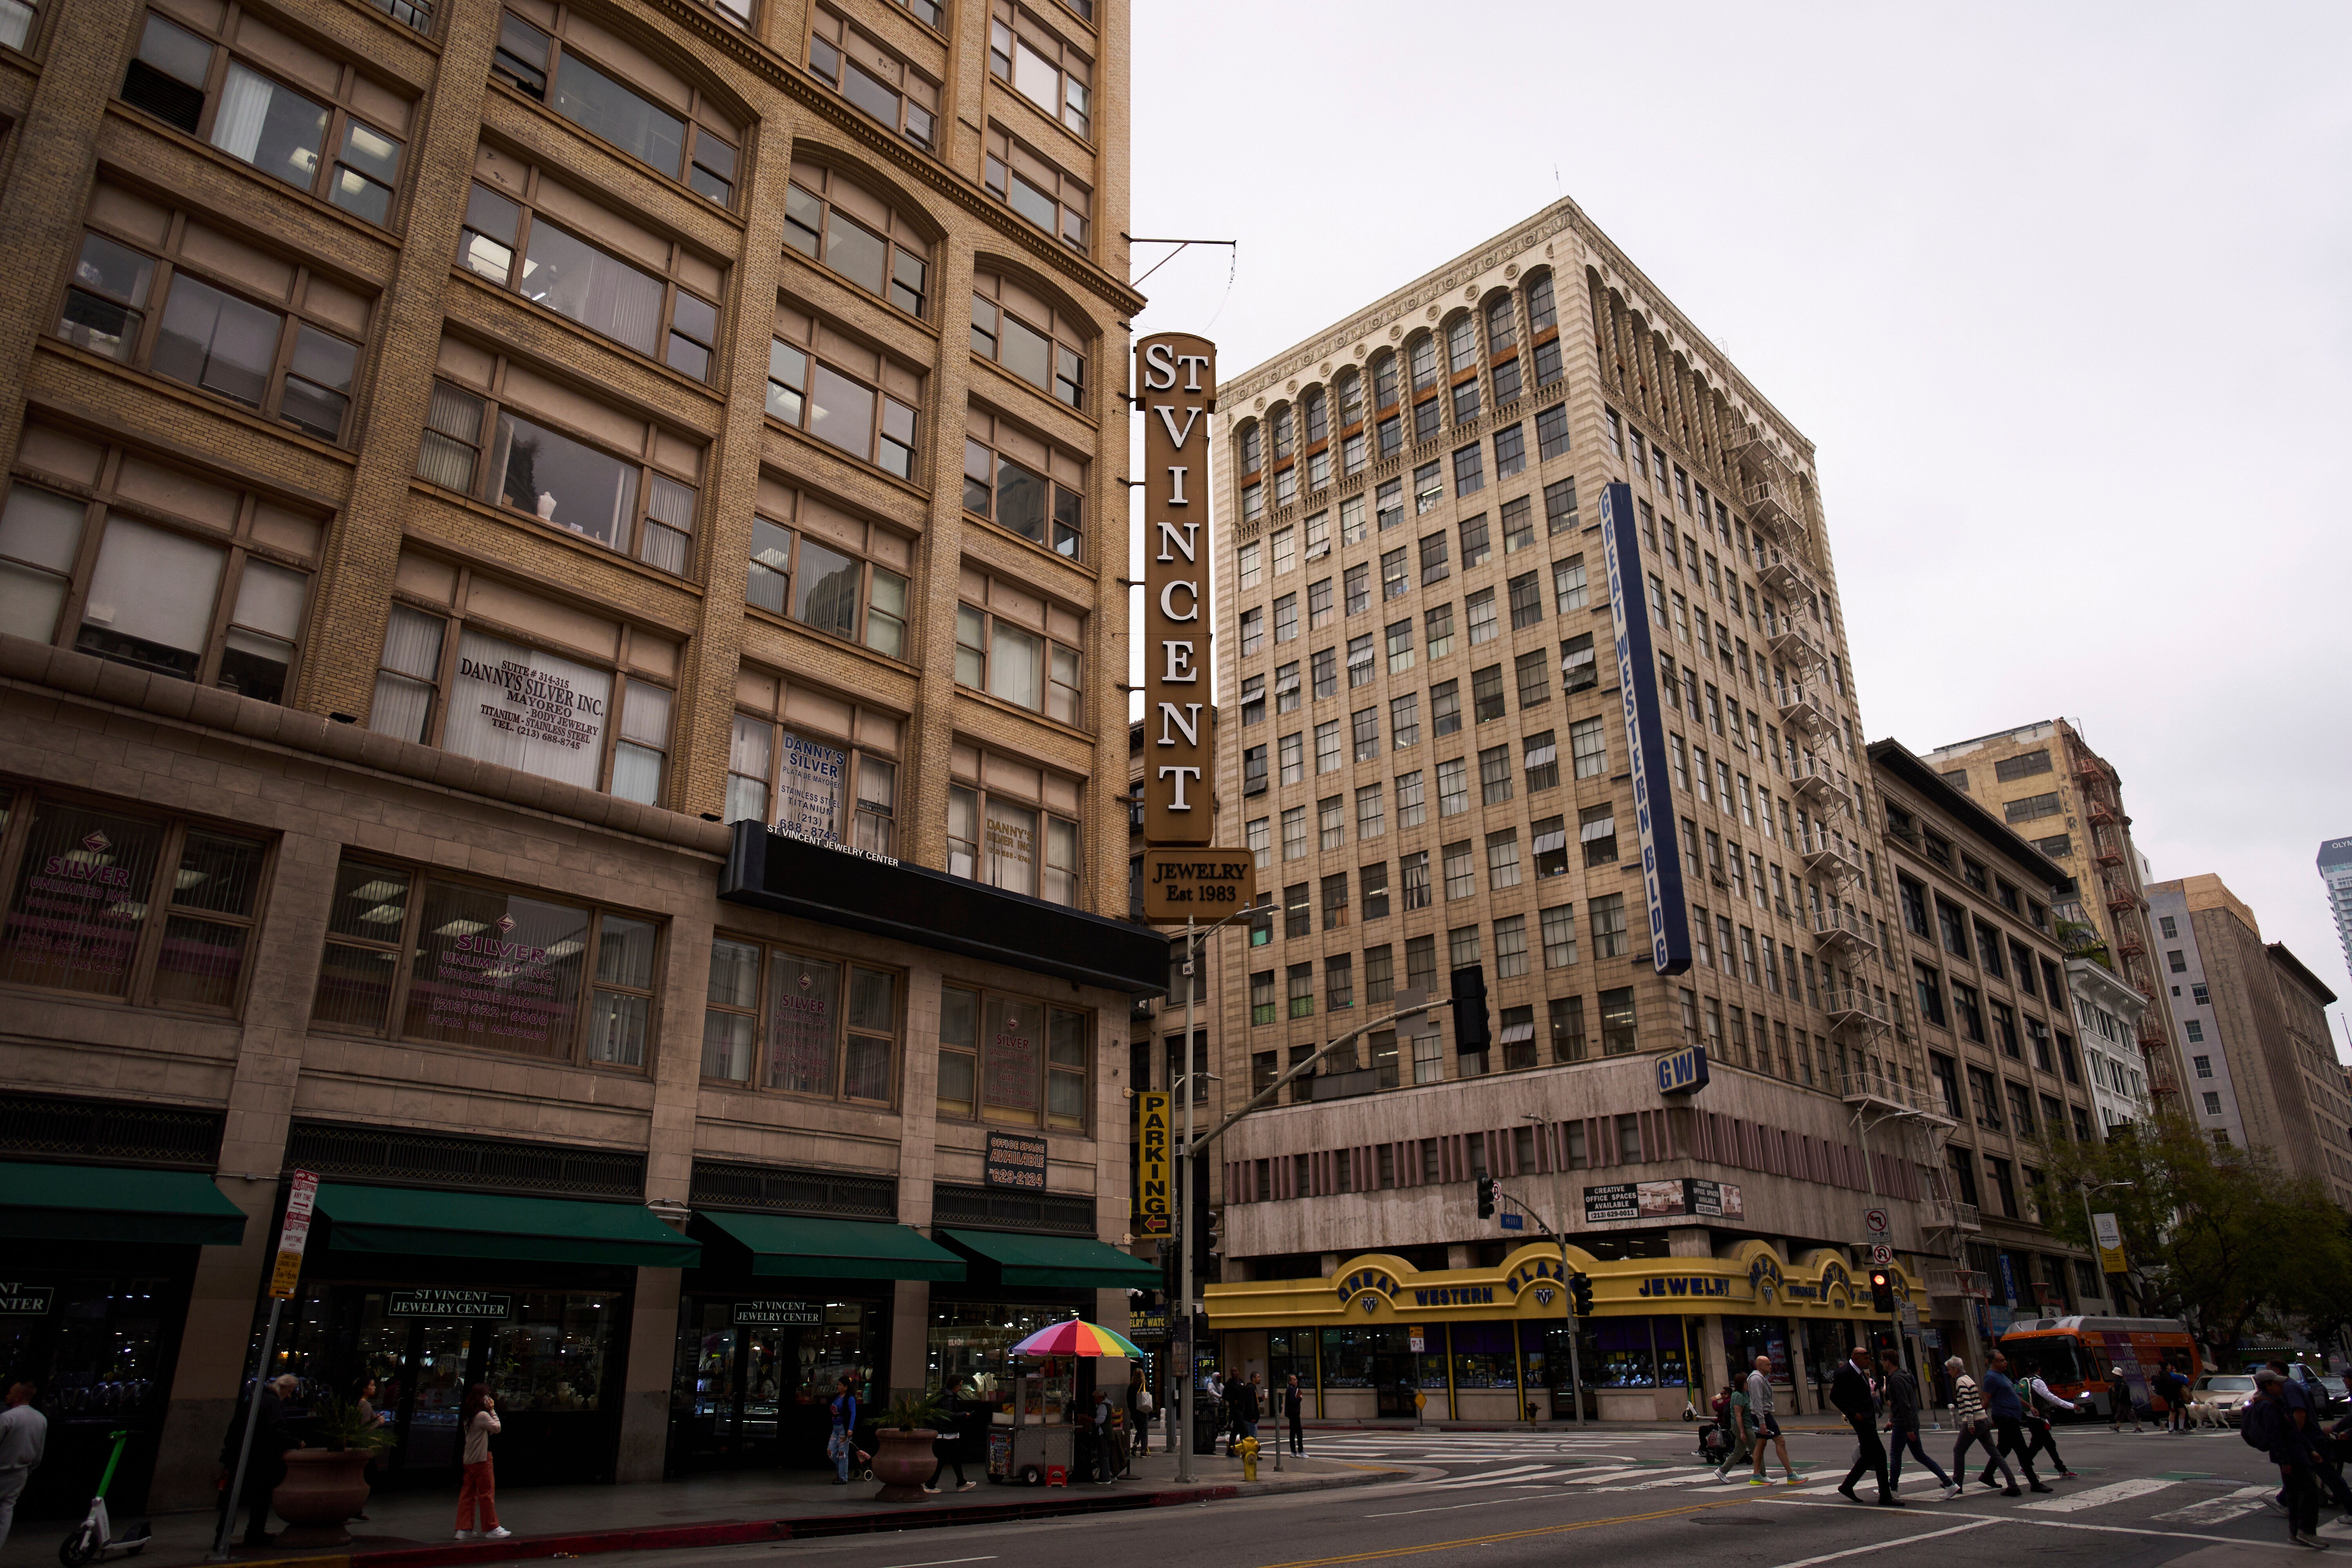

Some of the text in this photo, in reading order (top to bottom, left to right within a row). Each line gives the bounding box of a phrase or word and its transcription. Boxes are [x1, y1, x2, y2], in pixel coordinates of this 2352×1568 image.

[1145, 343, 1209, 811] ST VINCENT
[502, 661, 529, 676] SUITE
[539, 672, 569, 688] 314-315
[460, 658, 603, 717] DANNY'S SILVER INC.
[507, 691, 572, 717] MAYOREO
[481, 704, 590, 744] TITANIUM STAINLESS STEEL
[531, 709, 599, 736] BODY JEWELRY
[1601, 492, 1667, 967] GREAT WESTERN BLDG
[492, 718, 580, 750] TEL. (213) 688-8745
[784, 736, 844, 765] DANNY'S
[789, 753, 838, 778] SILVER
[783, 766, 842, 789] PLATA DE MAYOREO
[782, 785, 840, 809] STAINLESS STEEL
[788, 797, 833, 816] TITANIUM
[798, 812, 822, 826] (213)
[987, 818, 1034, 842] DANNY'S
[987, 831, 1013, 848] SILVER
[767, 825, 898, 867] ST. VINCENT JEWELRY CENTER
[1018, 855, 1031, 864] 8745
[45, 857, 129, 887] SILVER
[1152, 863, 1248, 883] JEWELRY
[30, 876, 134, 904] UNLIMITED INC.
[1166, 885, 1236, 901] Est 1983
[26, 896, 132, 922] WHOLESALE SILVER
[42, 918, 107, 936] SUITE 216
[456, 934, 547, 965] SILVER
[14, 952, 123, 975] PLATA DE MAYOREO
[443, 951, 555, 981] UNLIMITED INC.
[439, 966, 554, 996] WHOLESALE SILVER
[461, 988, 532, 1008] SUITE 216
[781, 994, 826, 1014] SILVER
[434, 997, 548, 1025] (213) 622 6800
[775, 1009, 813, 1024] UNLIMITED
[428, 1015, 546, 1041] PLATA DE MAYOREO
[774, 1025, 829, 1040] WHOLESALE SILVER
[784, 1040, 818, 1052] SUITE 216
[996, 1034, 1029, 1051] SILVER
[989, 1047, 1020, 1060] UNLIMITED
[800, 1069, 827, 1079] MAYOREO
[989, 1060, 1036, 1074] WHOLESALE SILVER
[1659, 1052, 1693, 1089] GW
[998, 1073, 1014, 1082] SUITE
[1012, 1099, 1036, 1108] MAYOREO
[991, 1138, 1044, 1153] OFFICE SPACE
[1145, 1097, 1165, 1214] PARKING
[989, 1149, 1044, 1167] AVAILABLE
[294, 1178, 316, 1193] NO STOPPING
[993, 1169, 1043, 1187] 629-2124
[1697, 1181, 1713, 1189] CREATIVE
[1586, 1192, 1636, 1203] OFFICE SPACES
[1594, 1186, 1624, 1194] CREATIVE
[1595, 1201, 1629, 1210] AVAILABLE
[1699, 1196, 1716, 1205] AVAILABLE
[285, 1219, 308, 1232] NO STOPPING
[285, 1235, 302, 1243] ANYTIME
[1749, 1258, 1784, 1288] GREAT
[2002, 1259, 2014, 1298] JEWELRY
[415, 1289, 488, 1301] ST VINCENT
[1338, 1272, 1730, 1305] GREAT WESTERN JEWELRY
[394, 1302, 504, 1314] JEWELRY CENTER
[752, 1301, 806, 1310] ST VINCENT
[737, 1312, 818, 1321] JEWELRY CENTER
